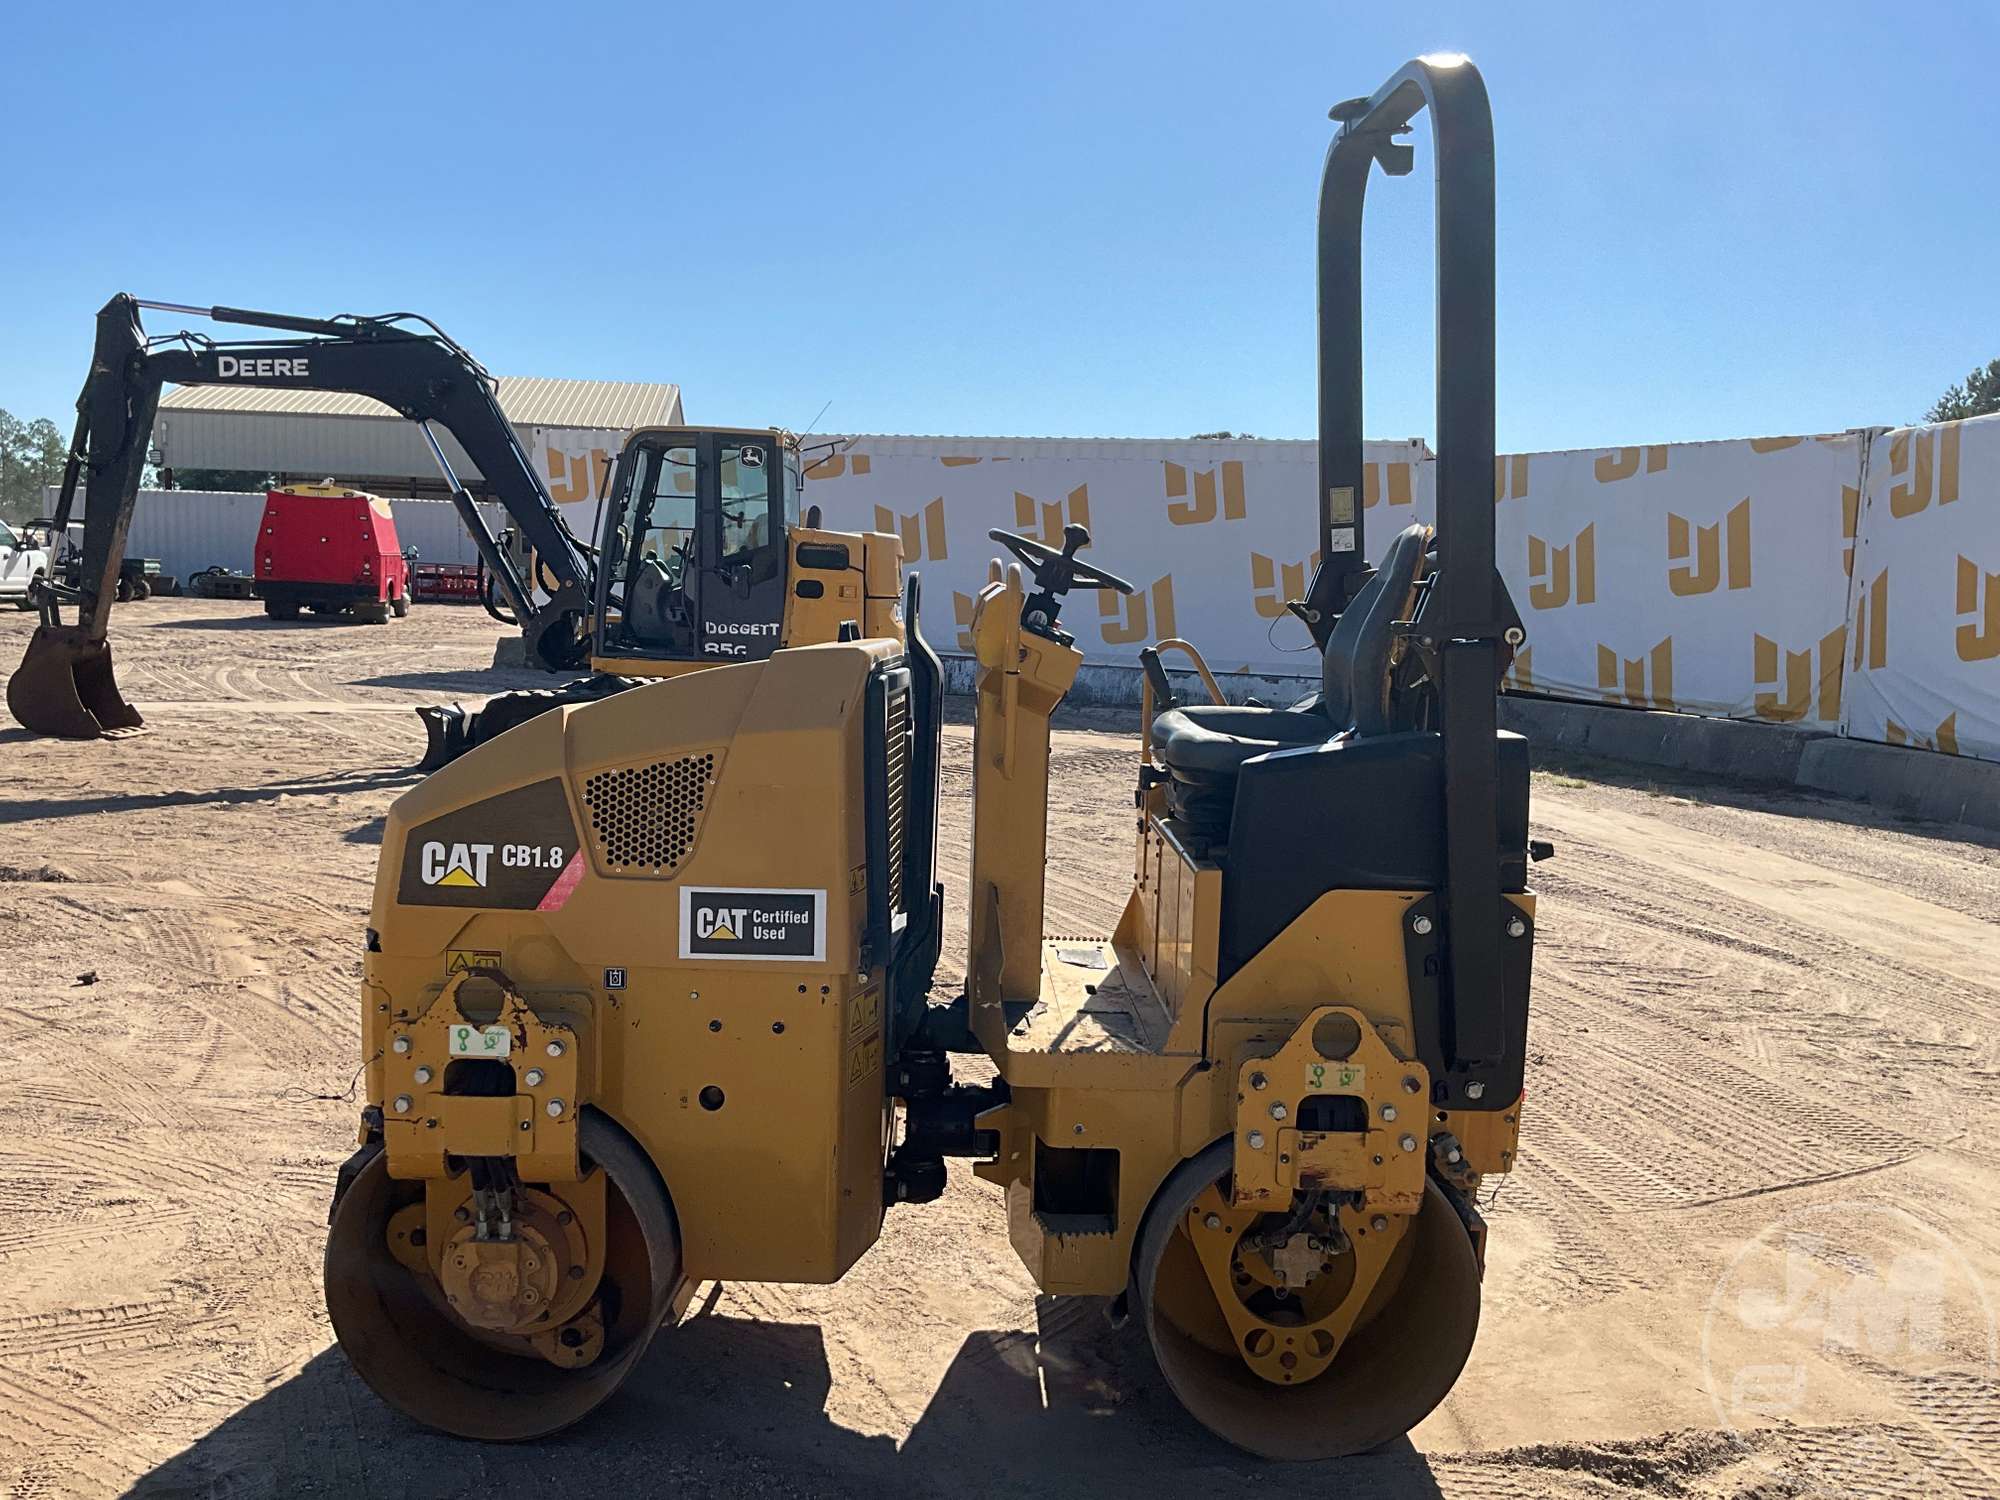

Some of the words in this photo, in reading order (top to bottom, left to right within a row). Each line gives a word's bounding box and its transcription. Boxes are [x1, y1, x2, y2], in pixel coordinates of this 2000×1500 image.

[218, 356, 309, 377] DEERE
[705, 621, 780, 635] DOGGETT
[422, 841, 494, 887] CAT
[502, 844, 563, 868] CB1.8
[753, 910, 809, 924] Certified
[753, 926, 786, 940] Used
